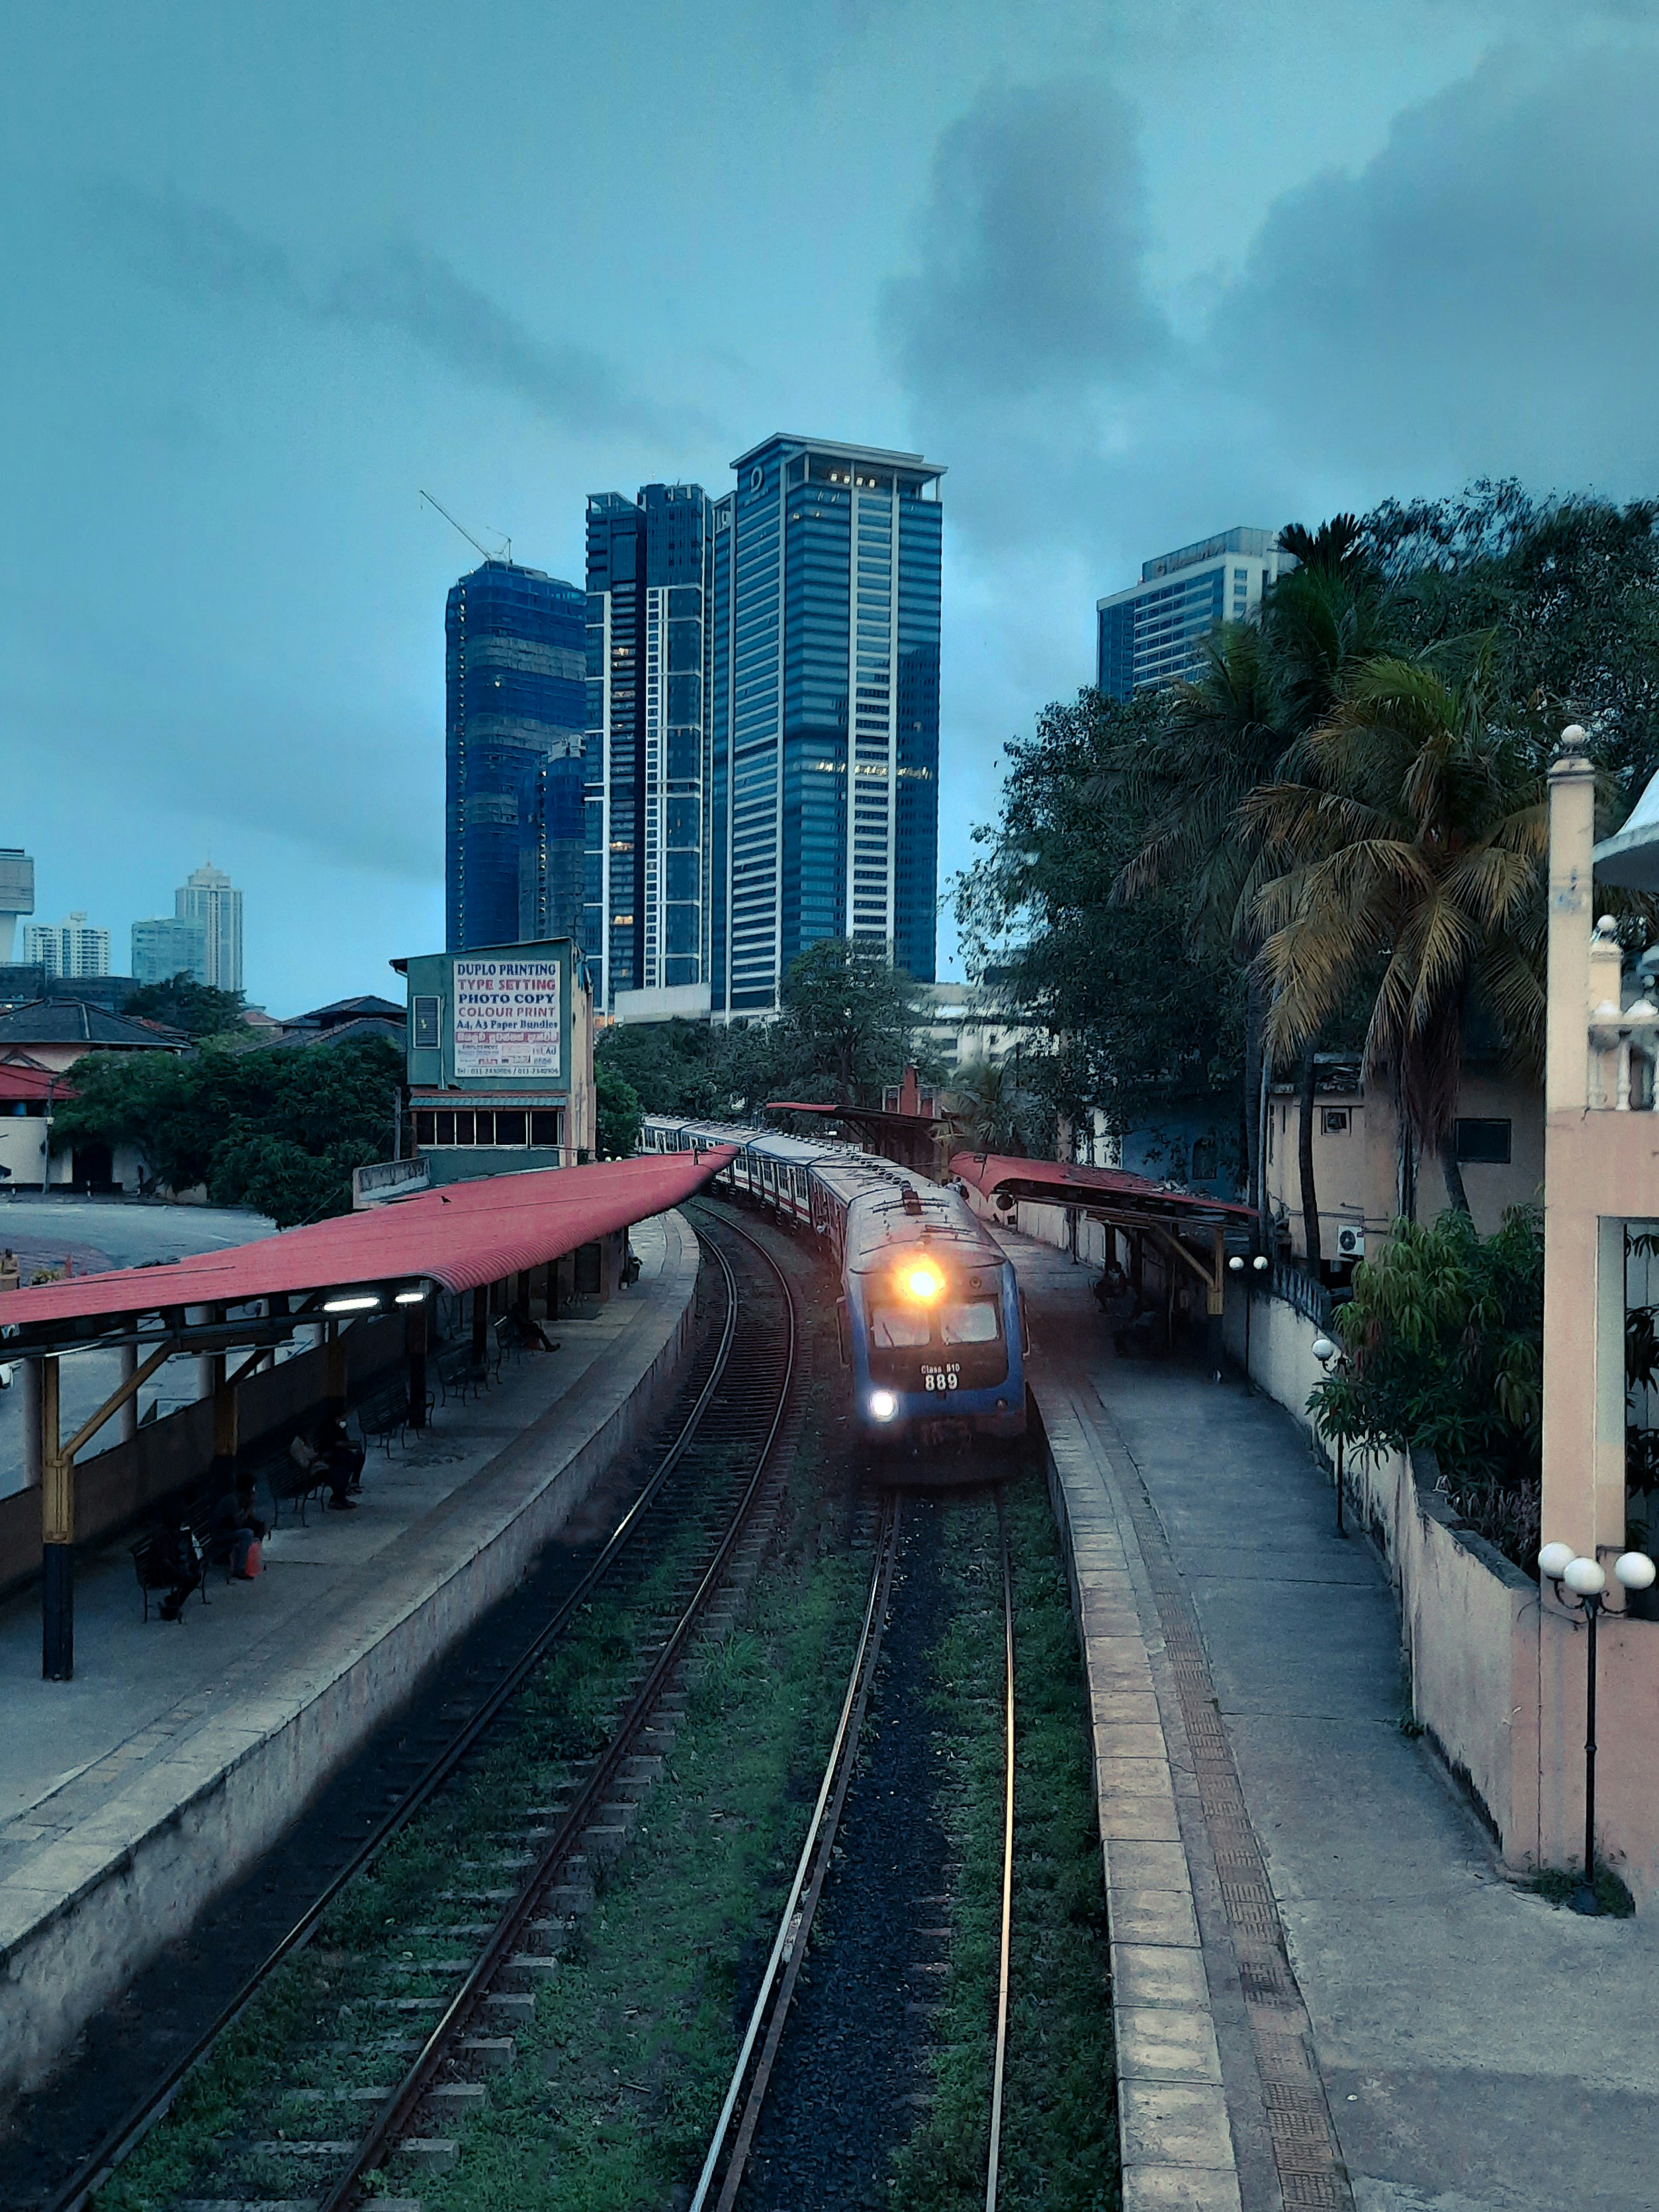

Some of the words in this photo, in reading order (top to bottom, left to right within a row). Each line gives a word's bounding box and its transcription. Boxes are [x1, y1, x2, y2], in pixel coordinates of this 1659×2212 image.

[457, 964, 496, 976] DUPLO
[499, 964, 556, 976] PRINTING
[458, 979, 494, 991] TYPE
[498, 979, 556, 991] SETTING
[459, 993, 510, 1004] PHOTO
[514, 993, 555, 1004] COPY
[459, 1007, 513, 1017] COLOUR
[517, 1007, 556, 1017] PRINT
[475, 1020, 488, 1029] A3
[490, 1021, 517, 1031] Paper
[520, 1019, 558, 1030] Bundles
[921, 1365, 942, 1374] Class
[925, 1373, 958, 1391] 889
